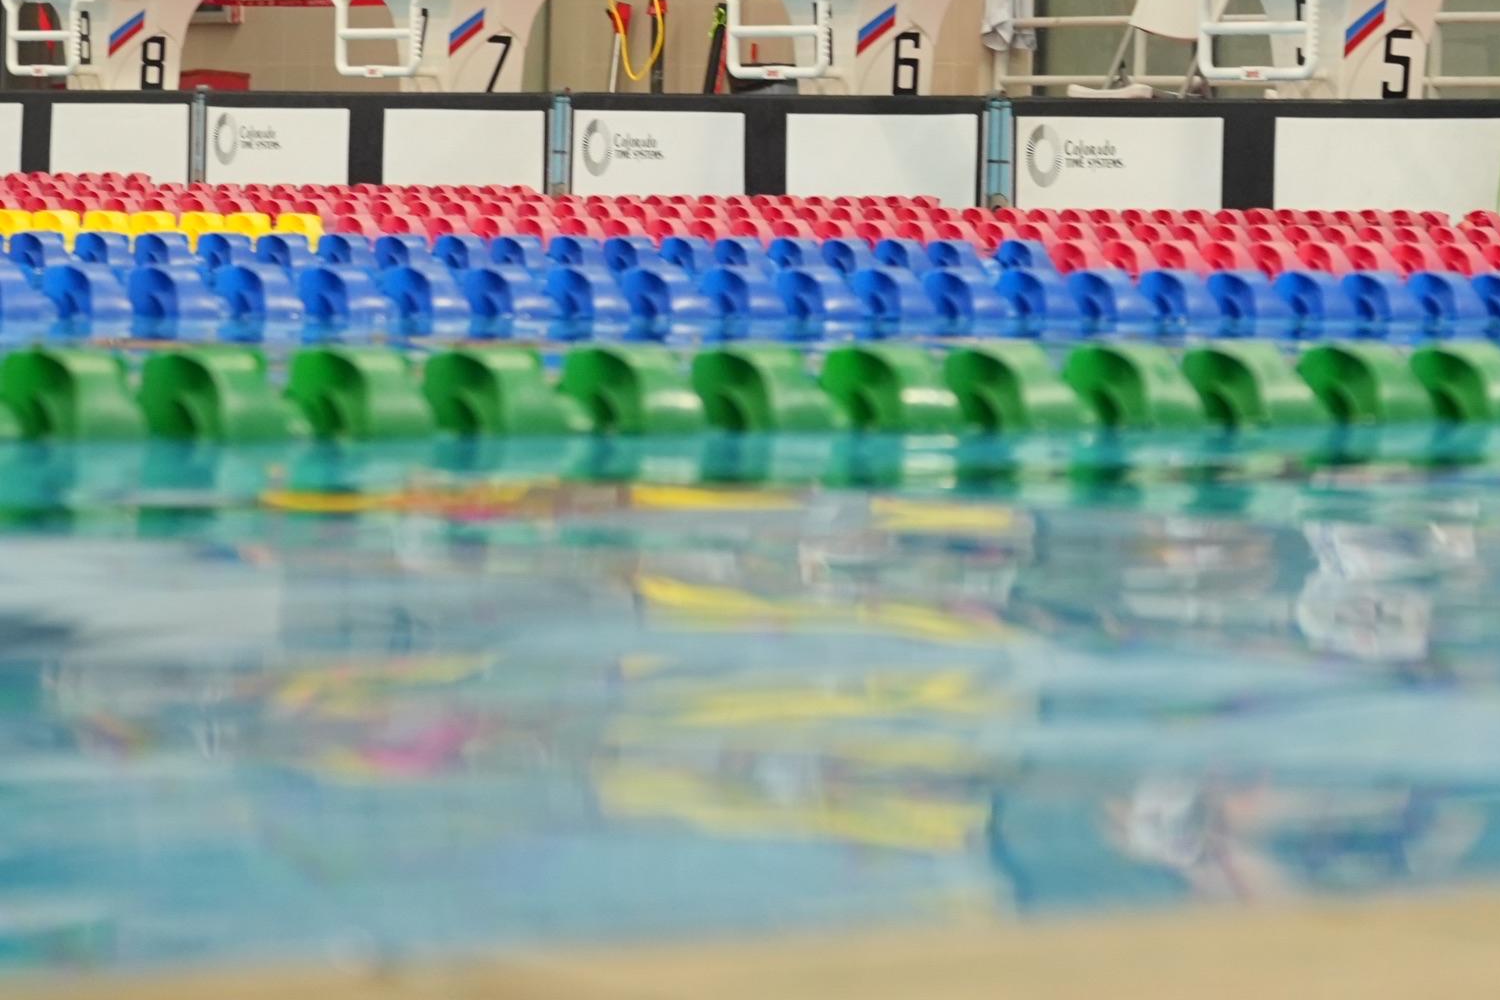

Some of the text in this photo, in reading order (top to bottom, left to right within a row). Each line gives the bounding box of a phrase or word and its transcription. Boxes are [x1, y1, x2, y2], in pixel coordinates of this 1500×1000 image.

[142, 37, 166, 90] 8
[487, 35, 512, 92] 7
[893, 32, 920, 95] 6
[1382, 29, 1413, 98] 5
[1064, 140, 1117, 157] Colorado
